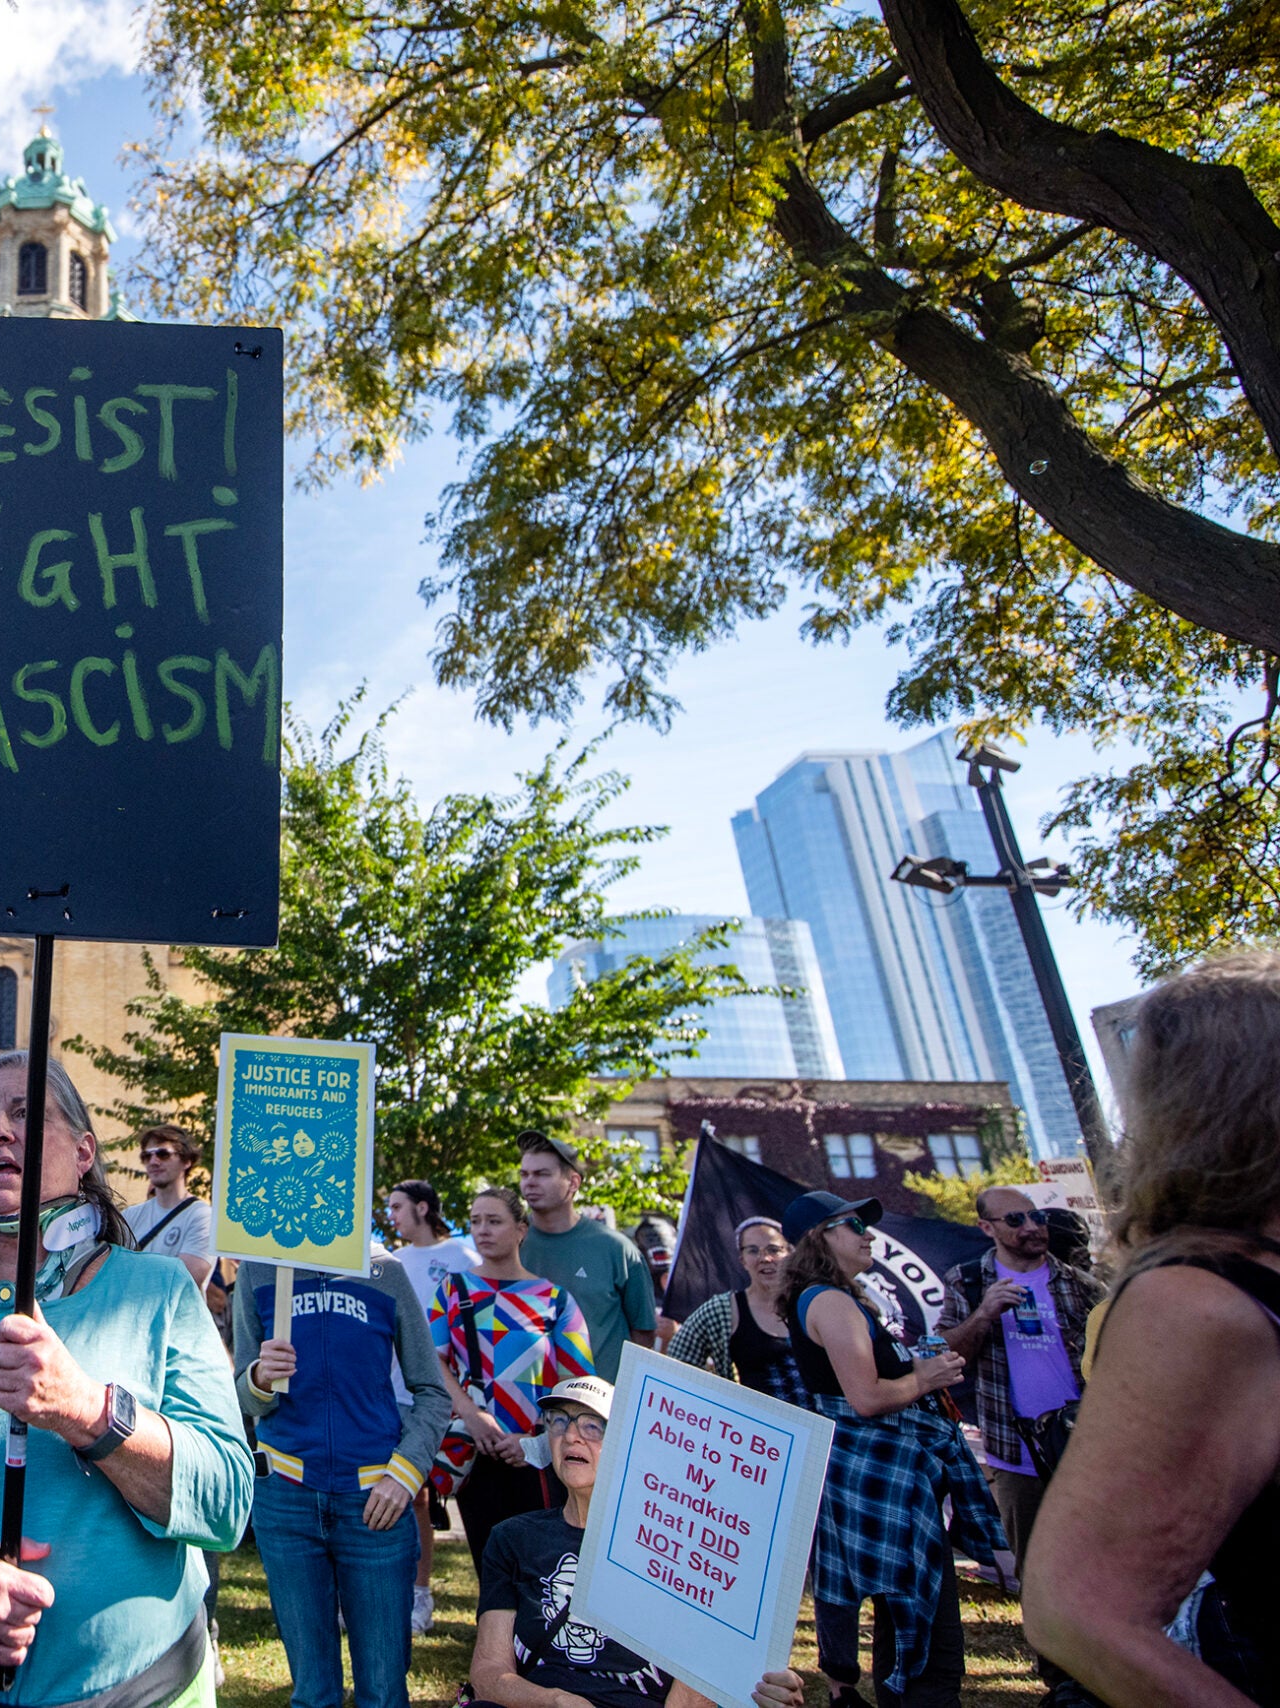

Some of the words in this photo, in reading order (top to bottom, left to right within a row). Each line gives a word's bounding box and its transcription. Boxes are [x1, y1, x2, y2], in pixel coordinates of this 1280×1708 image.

[241, 1064, 310, 1085] JUSTICE
[317, 1070, 351, 1089] FOR
[244, 1083, 318, 1101] IMMIGRANTS
[322, 1090, 346, 1103] AND
[266, 1103, 323, 1119] REFUGEES
[884, 1241, 944, 1307] YOU
[292, 1291, 368, 1323] REWERS
[566, 1382, 606, 1398] RESIST
[647, 1392, 654, 1408] I
[659, 1397, 712, 1432] Need
[718, 1420, 743, 1445] To
[749, 1434, 781, 1461] Be
[648, 1421, 695, 1453] Able
[702, 1443, 721, 1464] to
[729, 1453, 767, 1485] Tell
[686, 1463, 716, 1493] My
[643, 1472, 751, 1536] Grandkids
[643, 1500, 682, 1533] that
[687, 1521, 694, 1538] I
[700, 1528, 740, 1560] DID
[637, 1524, 683, 1561] NOT
[688, 1550, 737, 1591] Stay
[647, 1558, 715, 1608] Silent!
